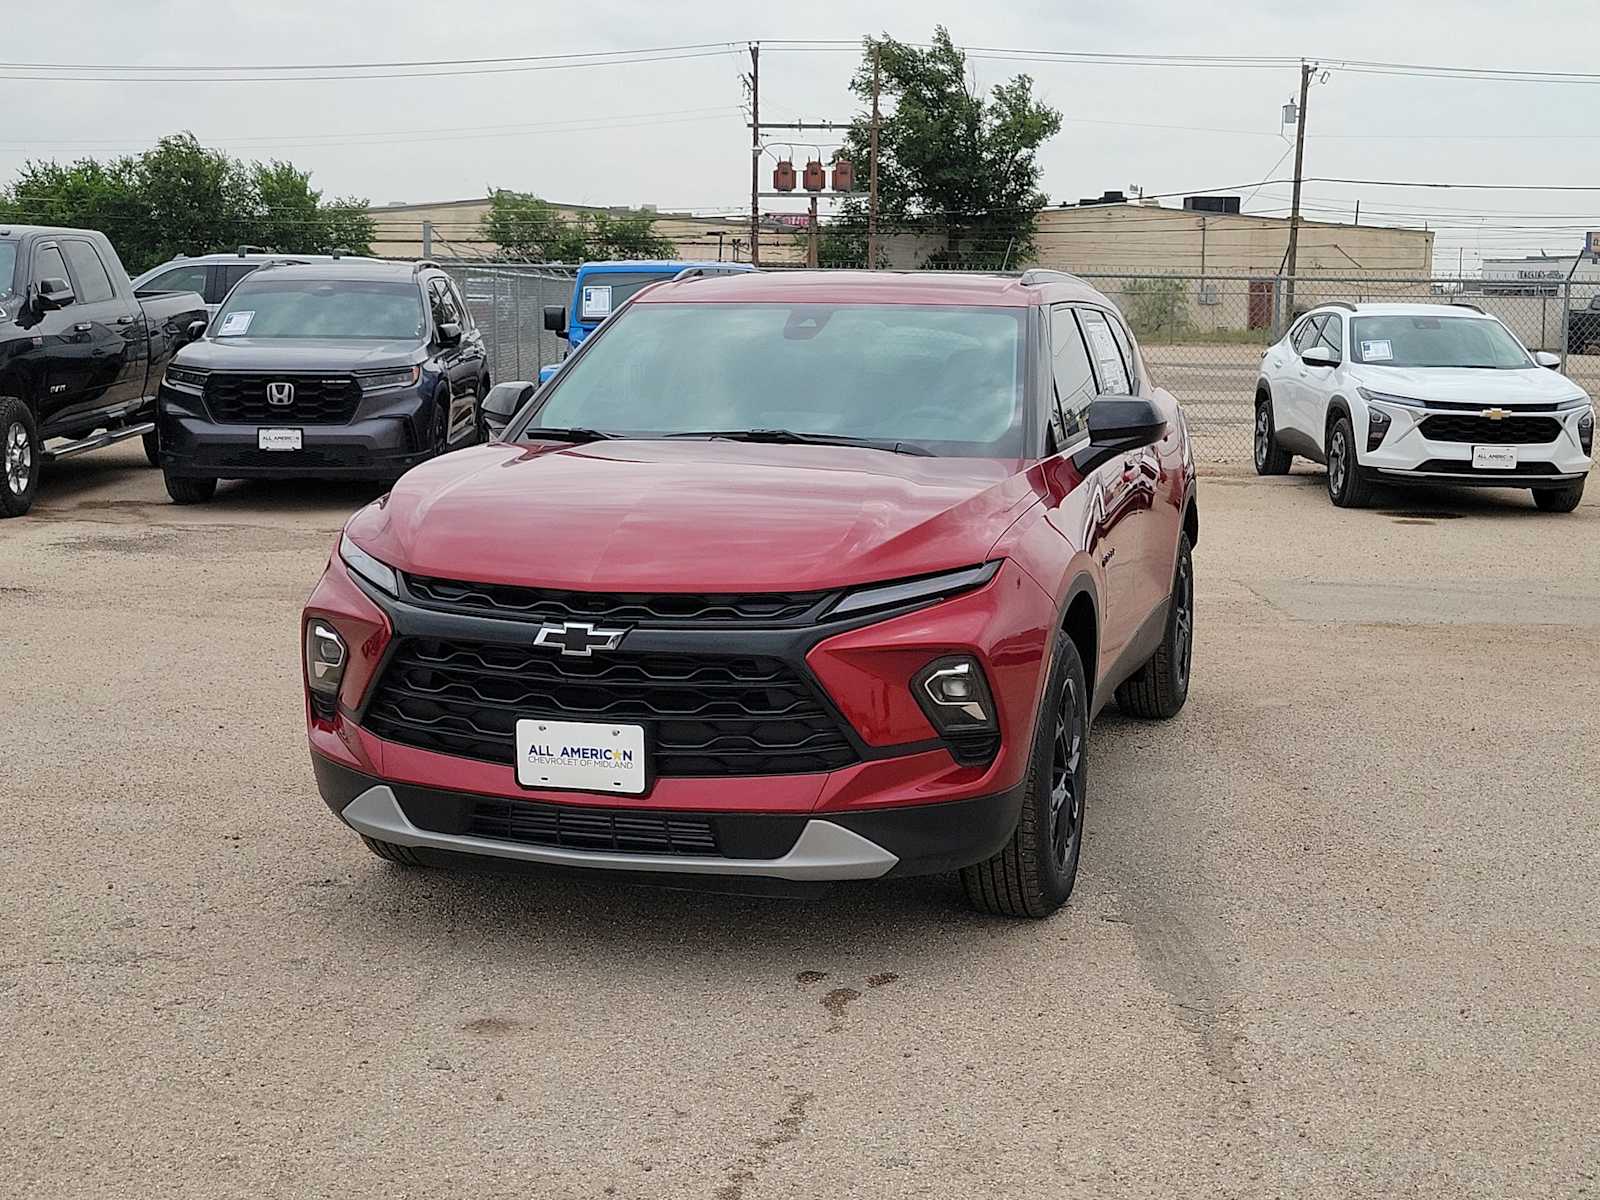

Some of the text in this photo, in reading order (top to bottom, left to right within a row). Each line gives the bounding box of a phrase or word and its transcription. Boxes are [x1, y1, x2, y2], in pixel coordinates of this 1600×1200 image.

[528, 744, 554, 757] ALL
[528, 756, 633, 770] CHEVROLET OF MIDLAND
